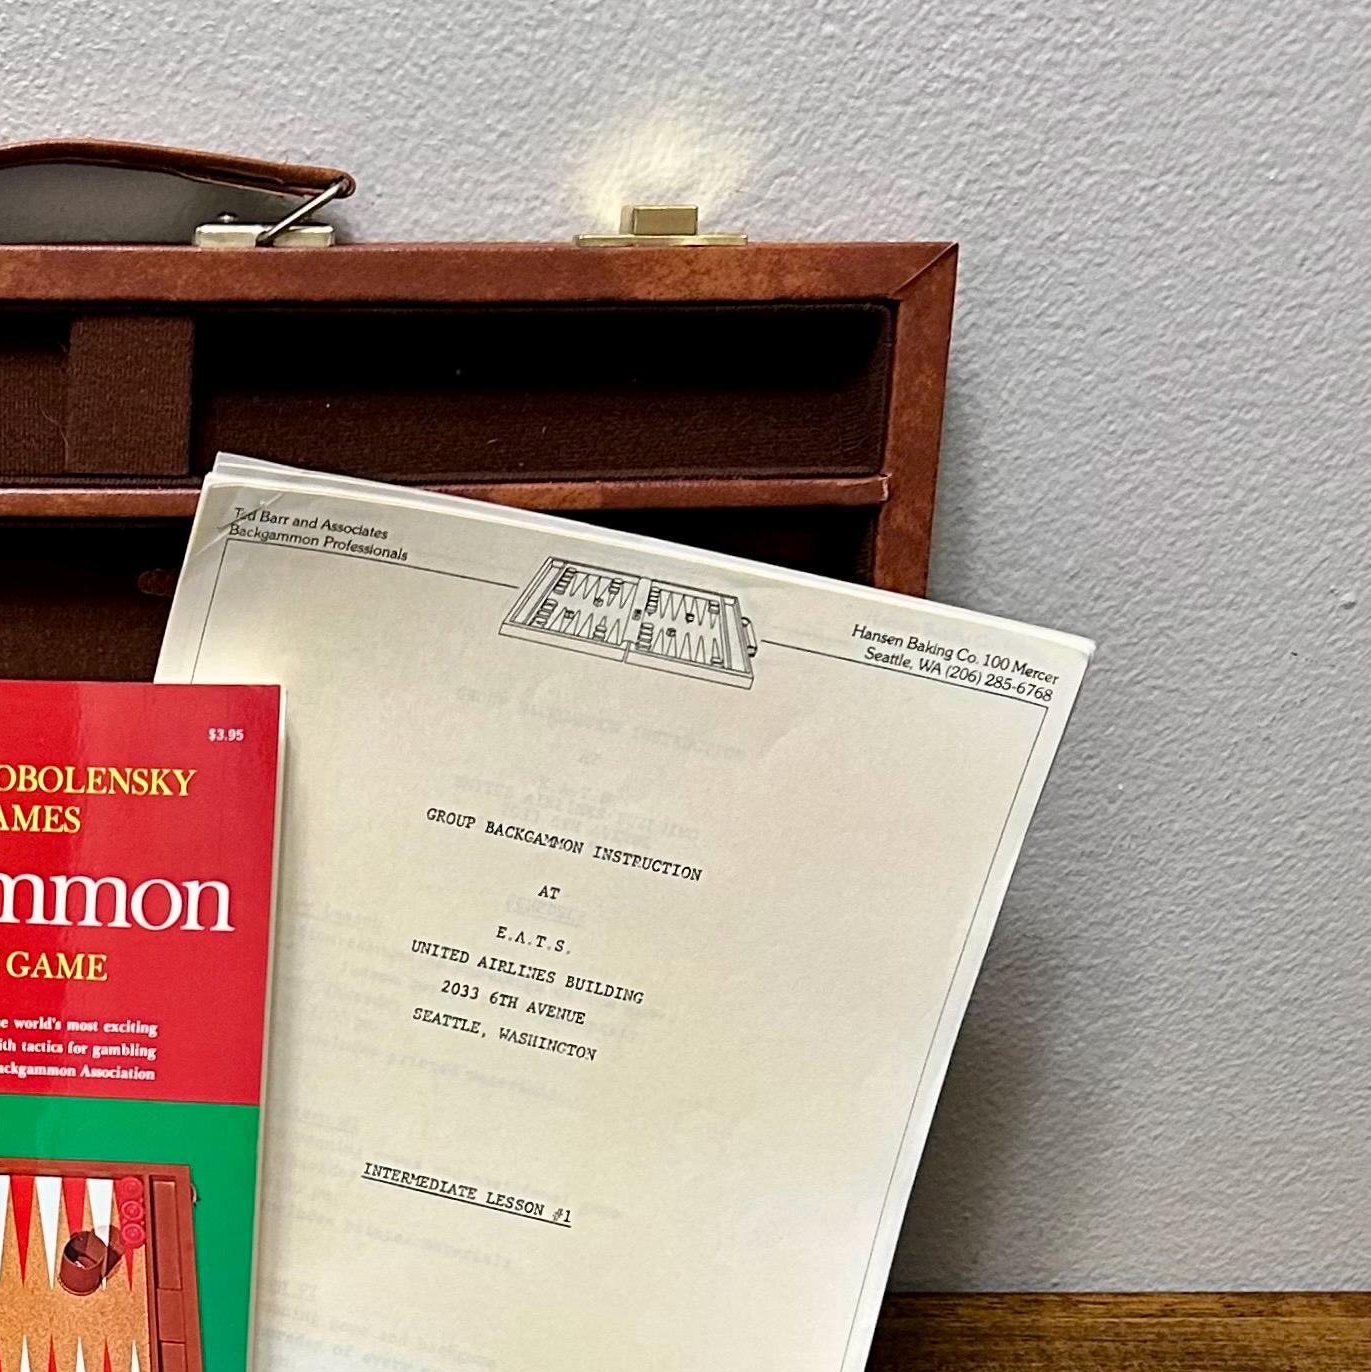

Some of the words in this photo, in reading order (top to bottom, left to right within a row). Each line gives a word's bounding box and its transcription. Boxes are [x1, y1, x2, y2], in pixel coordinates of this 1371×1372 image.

[229, 523, 319, 546] Backgammon
[323, 536, 408, 562] Professionals
[260, 510, 290, 525] Barr
[292, 517, 318, 530] and
[320, 518, 388, 540] Associates
[851, 624, 904, 648] Hansen
[906, 636, 954, 661] Baking
[957, 648, 979, 665] Co.
[983, 654, 1011, 671] 100
[1011, 660, 1060, 685] Mercer
[864, 646, 913, 670] Seattle,
[919, 658, 942, 676] WA
[945, 665, 982, 686] (206)
[984, 673, 1053, 702] 285-6768
[208, 727, 244, 742] $3.95
[426, 807, 477, 830] GROUP
[484, 820, 585, 855] BACKGAMMON
[592, 845, 703, 882] INSTRUCTION
[537, 885, 561, 901] AT
[496, 925, 571, 955] E.A.T.S.
[5, 951, 108, 982] GAME
[411, 939, 470, 964] UNITED
[476, 956, 557, 984] AIRLINES
[564, 975, 645, 1005] BUILDING
[441, 980, 480, 1000] 2033
[489, 991, 519, 1010] 6TH
[526, 1001, 586, 1025] AVENUE
[13, 1016, 62, 1031] world's
[66, 1020, 98, 1033] most
[103, 1019, 158, 1038] exciting
[412, 1007, 487, 1039] SEATTLE,
[499, 1027, 597, 1062] WASHINGTON
[21, 1040, 64, 1054] tactics
[67, 1041, 88, 1055] for
[92, 1043, 157, 1062] gambling
[80, 1064, 156, 1081] Association
[364, 1162, 478, 1200] INTERMEDIATE
[486, 1191, 545, 1216] LESSON
